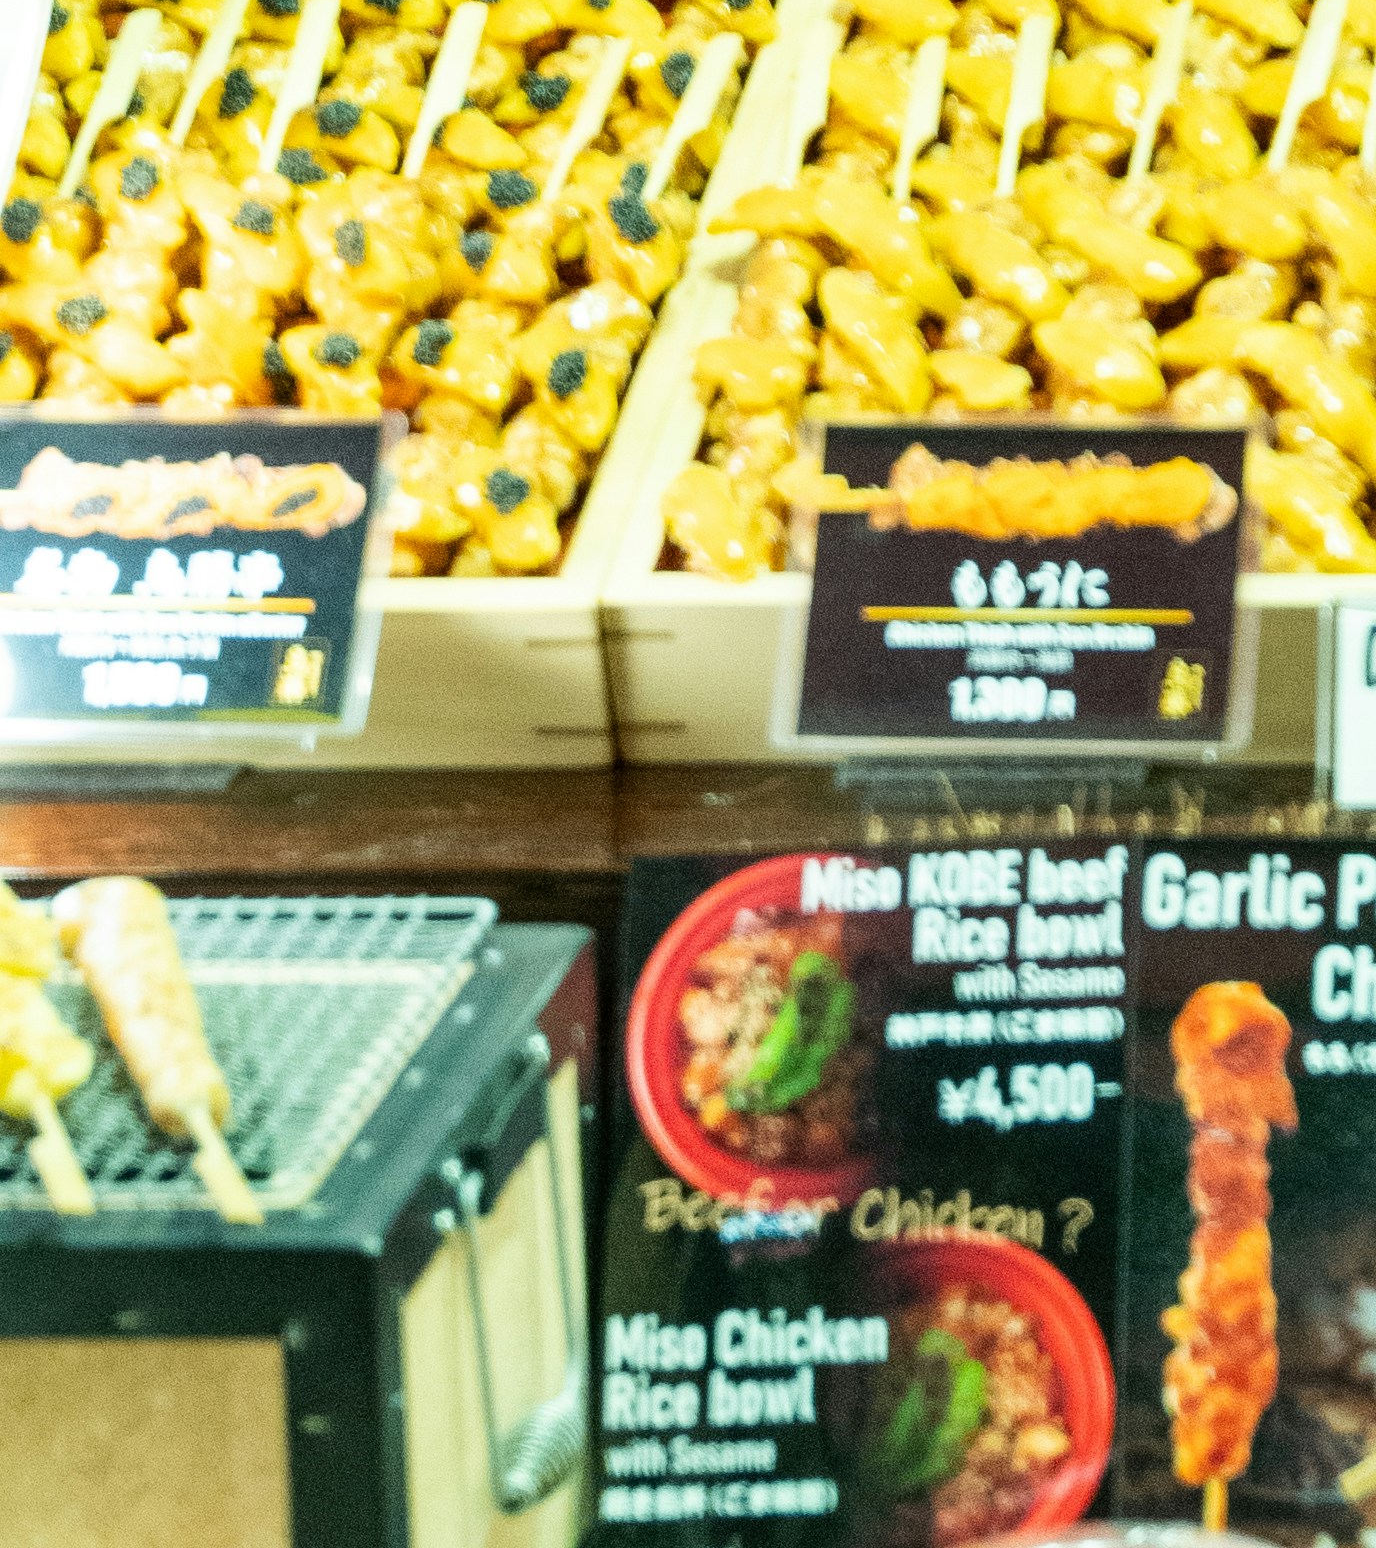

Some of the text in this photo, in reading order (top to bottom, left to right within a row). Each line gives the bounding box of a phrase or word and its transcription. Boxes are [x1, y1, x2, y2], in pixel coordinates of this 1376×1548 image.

[801, 847, 1126, 910] Miso KOBE beef
[1141, 853, 1326, 930] Garlic
[913, 902, 1125, 964] Rice bowl
[604, 1306, 891, 1371] Miso Chicken
[603, 1366, 815, 1431] Rice bowl
